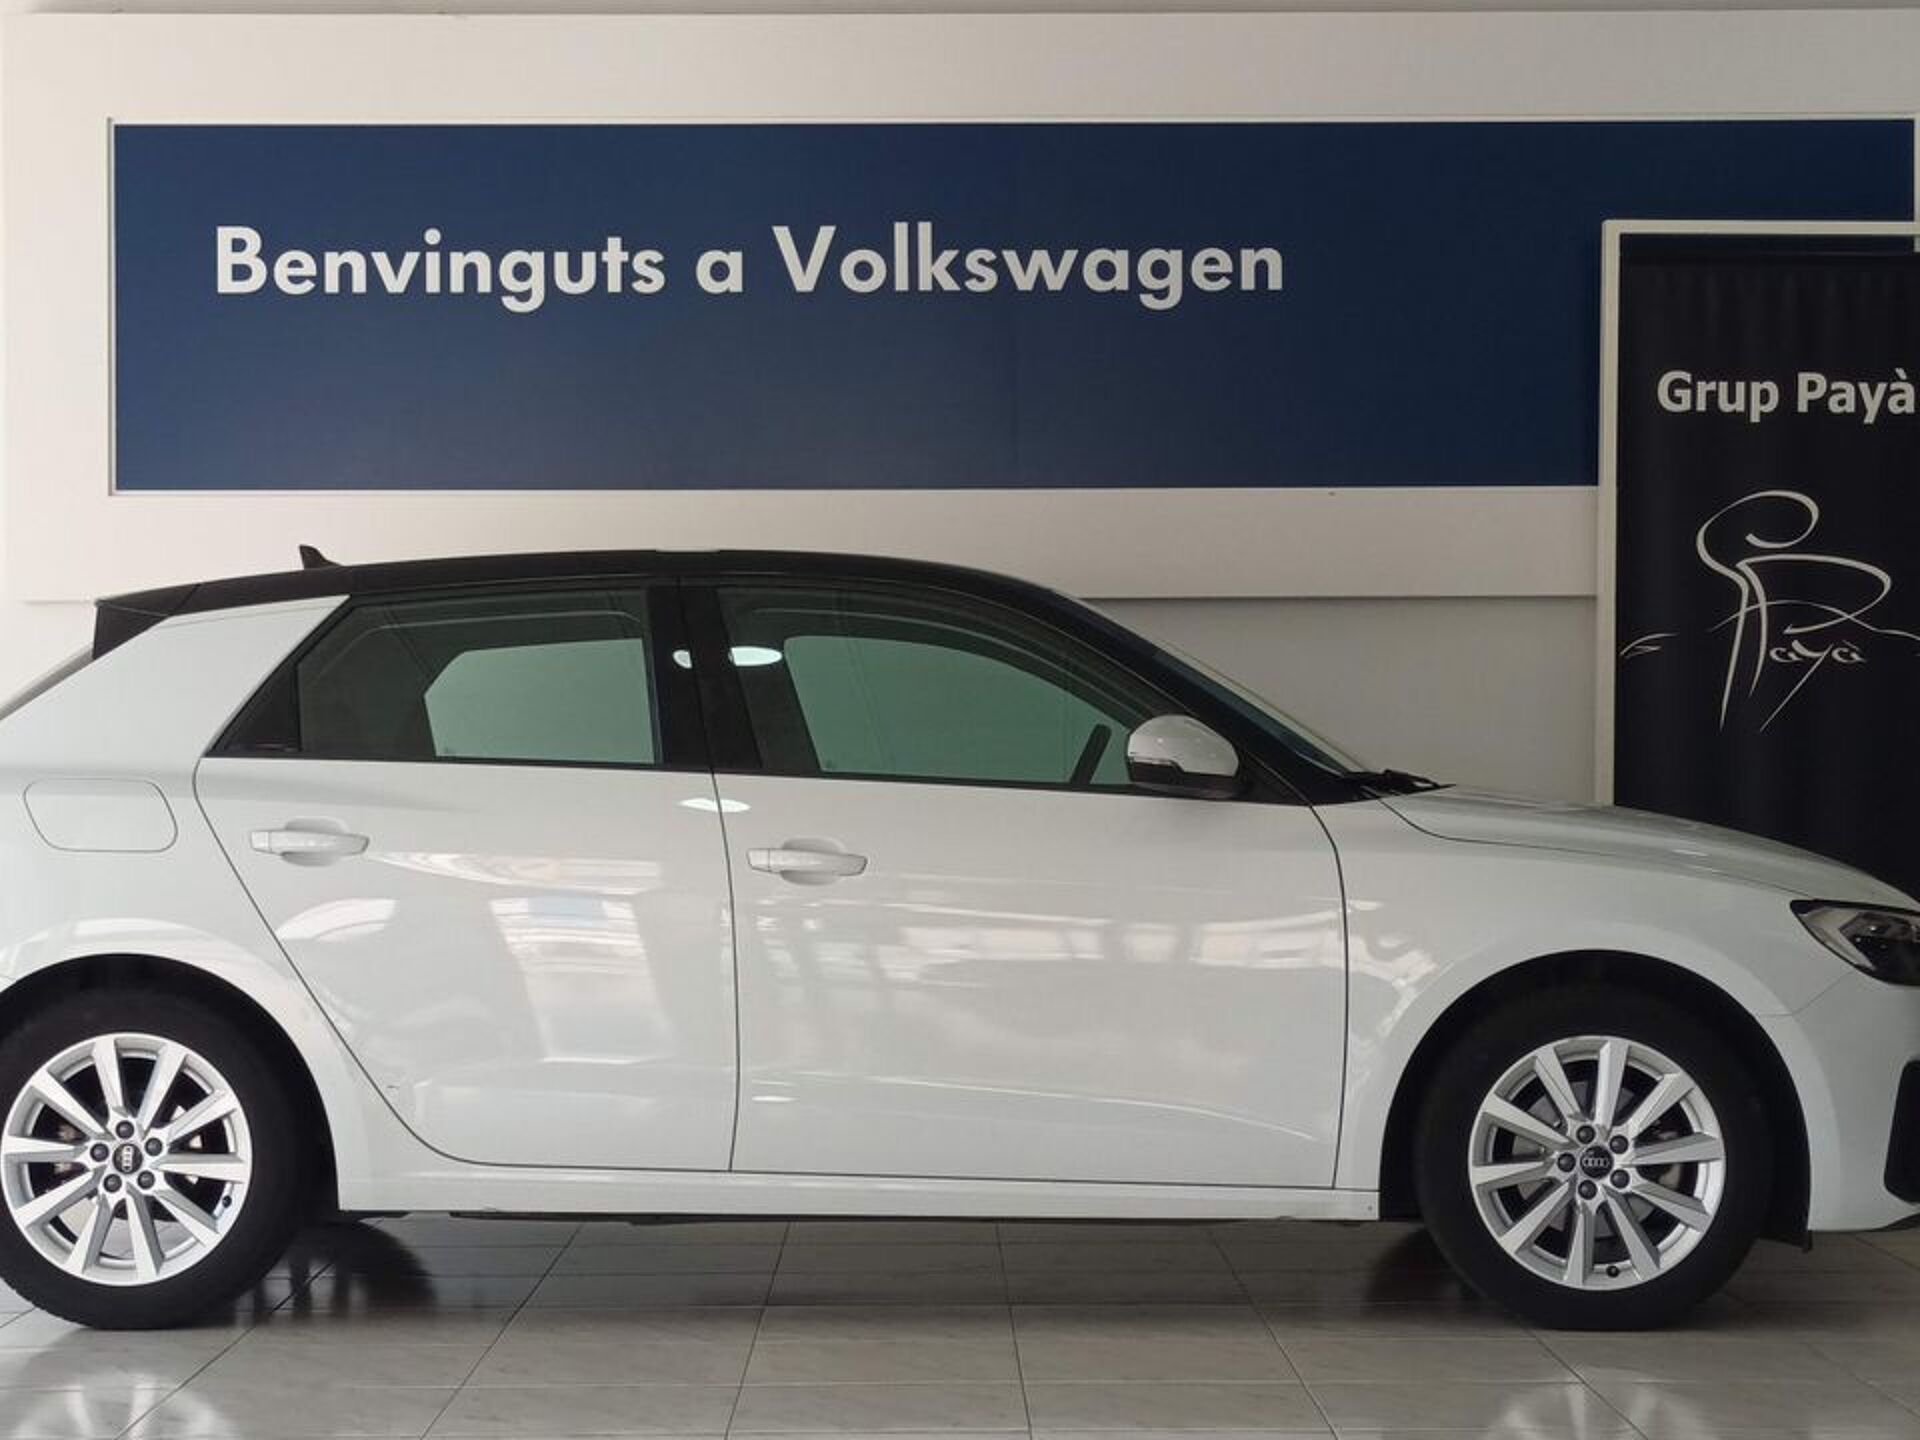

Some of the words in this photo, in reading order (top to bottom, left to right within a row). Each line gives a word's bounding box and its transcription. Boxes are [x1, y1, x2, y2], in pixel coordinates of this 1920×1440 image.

[215, 225, 666, 314] Benvinguts
[695, 249, 744, 295] a
[771, 220, 1284, 311] Volkswagen
[1656, 370, 1780, 424] Grup
[1796, 367, 1915, 425] Payà
